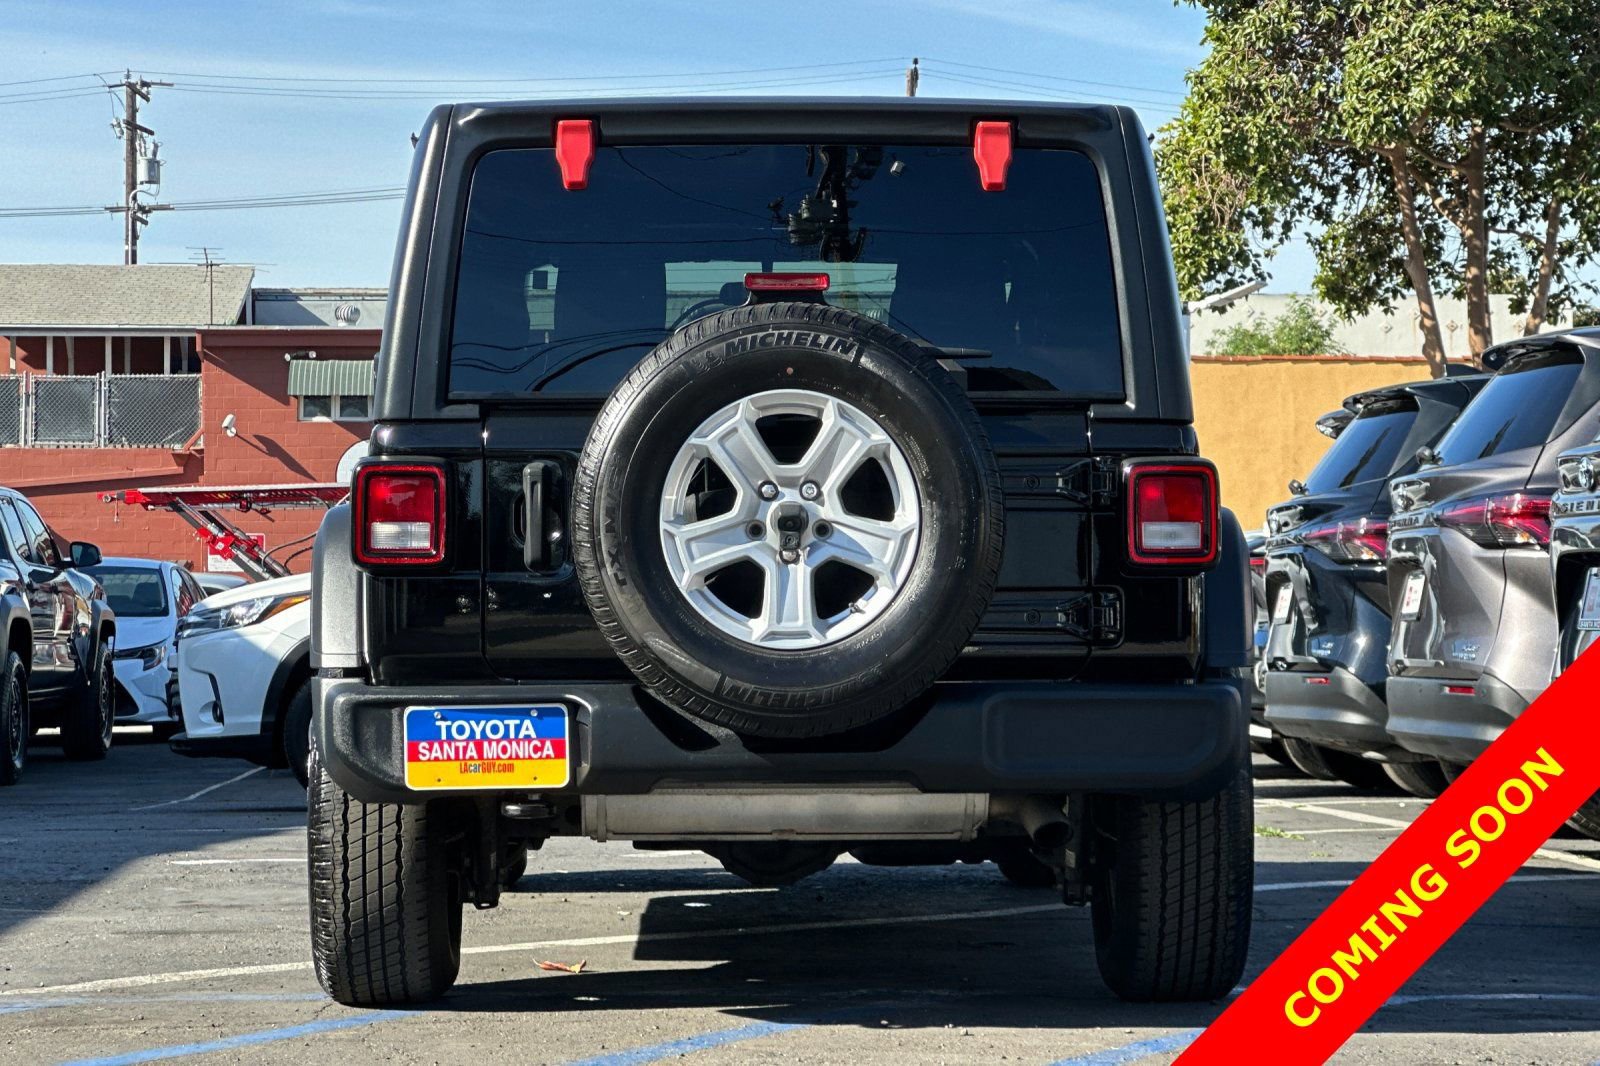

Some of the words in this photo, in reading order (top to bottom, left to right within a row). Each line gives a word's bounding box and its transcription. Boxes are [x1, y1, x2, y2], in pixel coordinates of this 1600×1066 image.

[724, 331, 858, 356] MICHELIN
[1562, 500, 1600, 513] SIEN
[435, 719, 536, 740] TOYOTA
[418, 741, 479, 761] SANTA
[483, 740, 555, 760] MONICA
[459, 762, 515, 774] LAcarGUY.com
